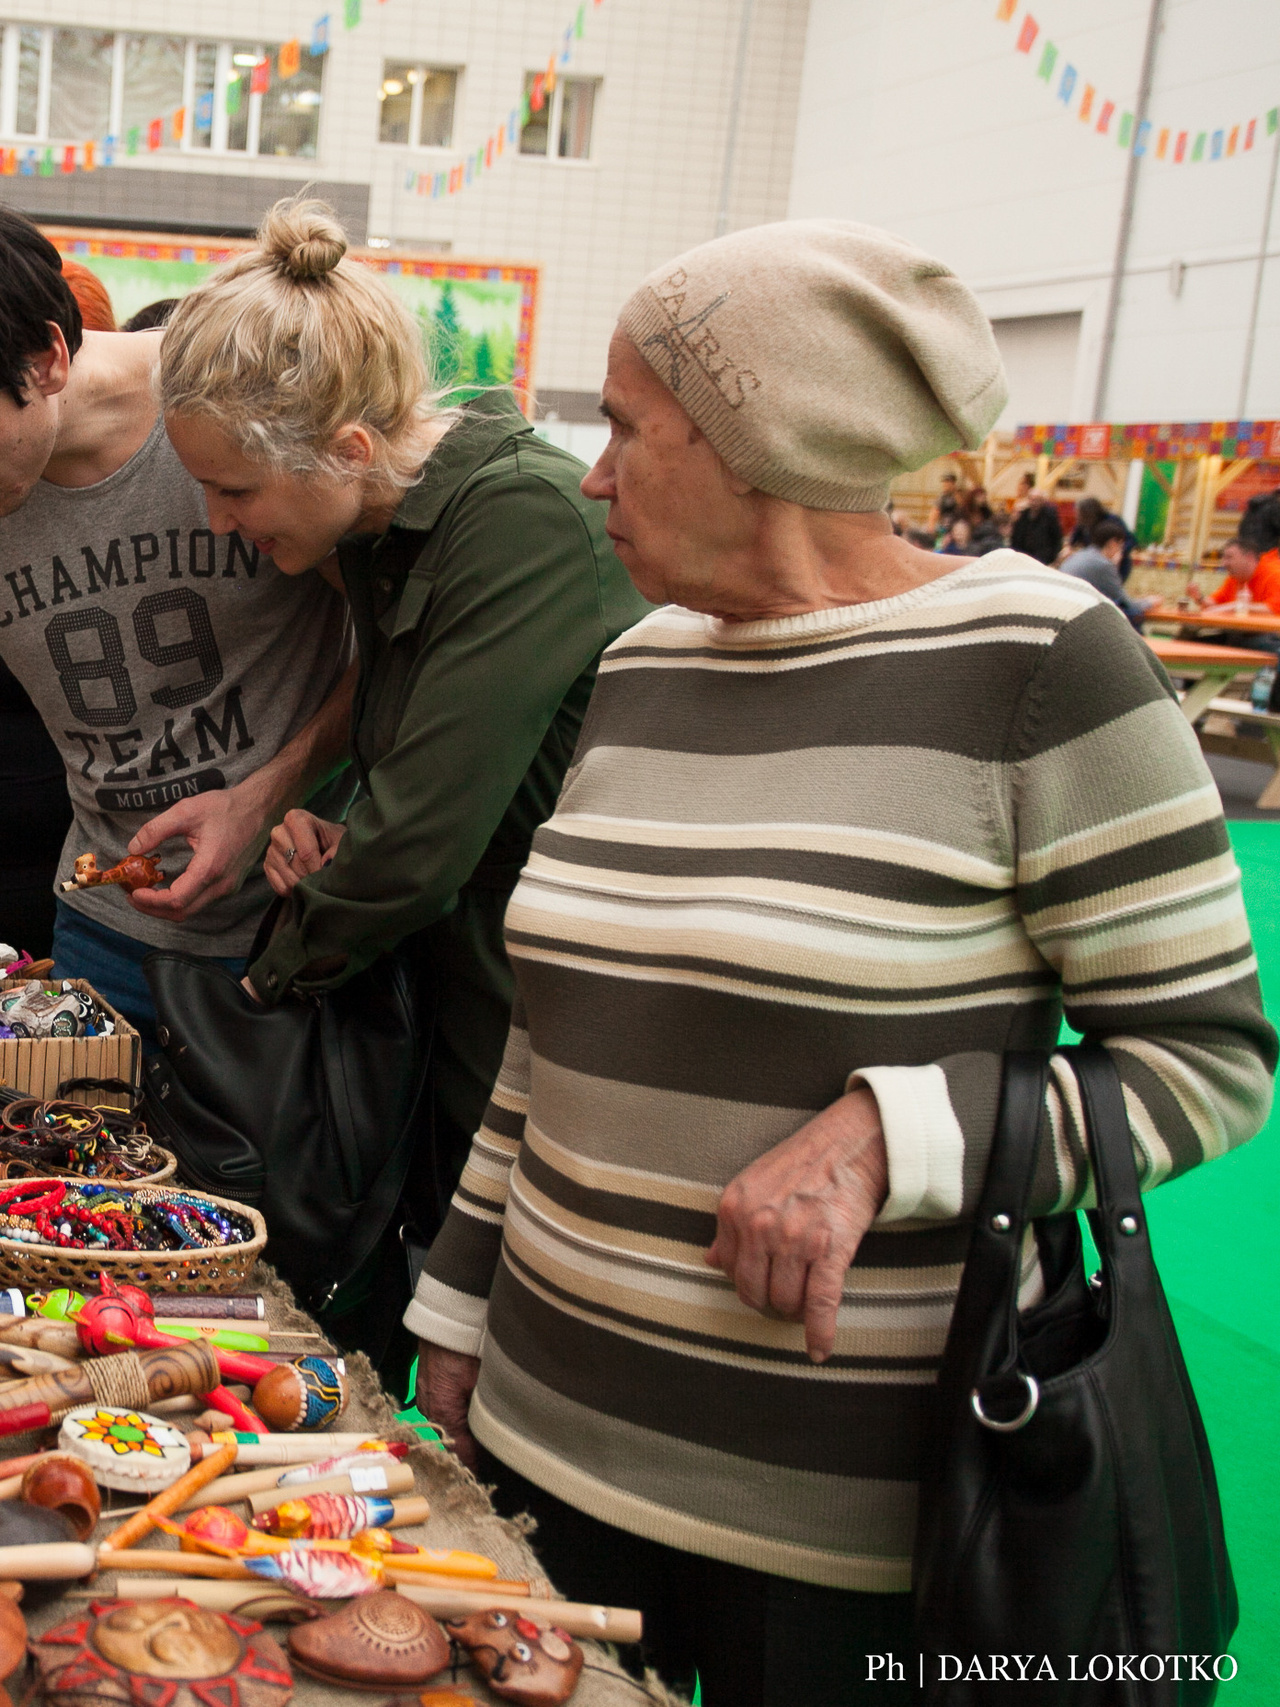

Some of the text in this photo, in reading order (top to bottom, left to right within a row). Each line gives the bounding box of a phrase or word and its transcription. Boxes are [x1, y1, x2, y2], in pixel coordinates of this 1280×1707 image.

[43, 586, 224, 727] 89
[64, 687, 255, 783] TEAM
[115, 777, 202, 809] MOTION
